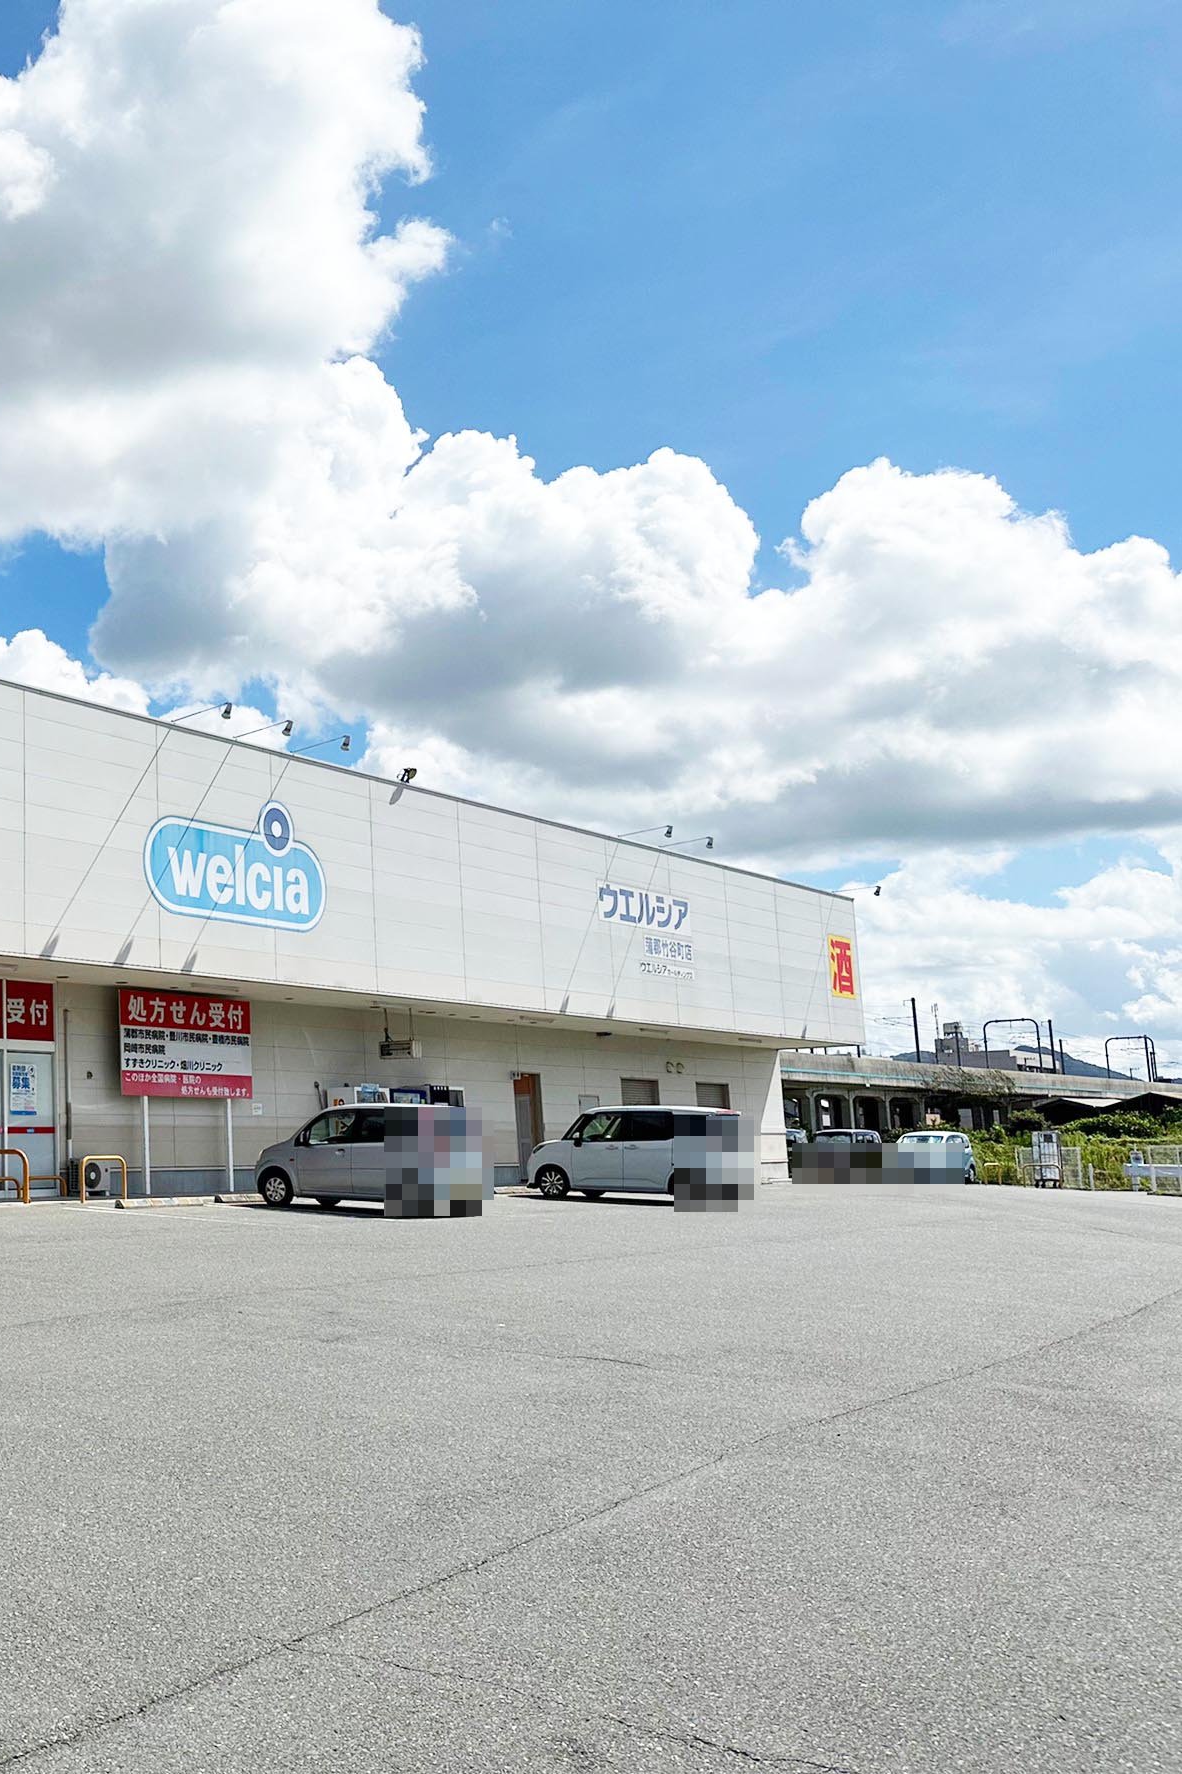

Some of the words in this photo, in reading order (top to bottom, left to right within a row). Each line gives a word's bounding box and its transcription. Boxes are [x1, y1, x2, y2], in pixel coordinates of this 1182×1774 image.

[167, 843, 310, 915] welcia
[599, 884, 688, 930] ウエルシア
[830, 940, 854, 995] 酒
[127, 994, 244, 1030] 処方せん受付
